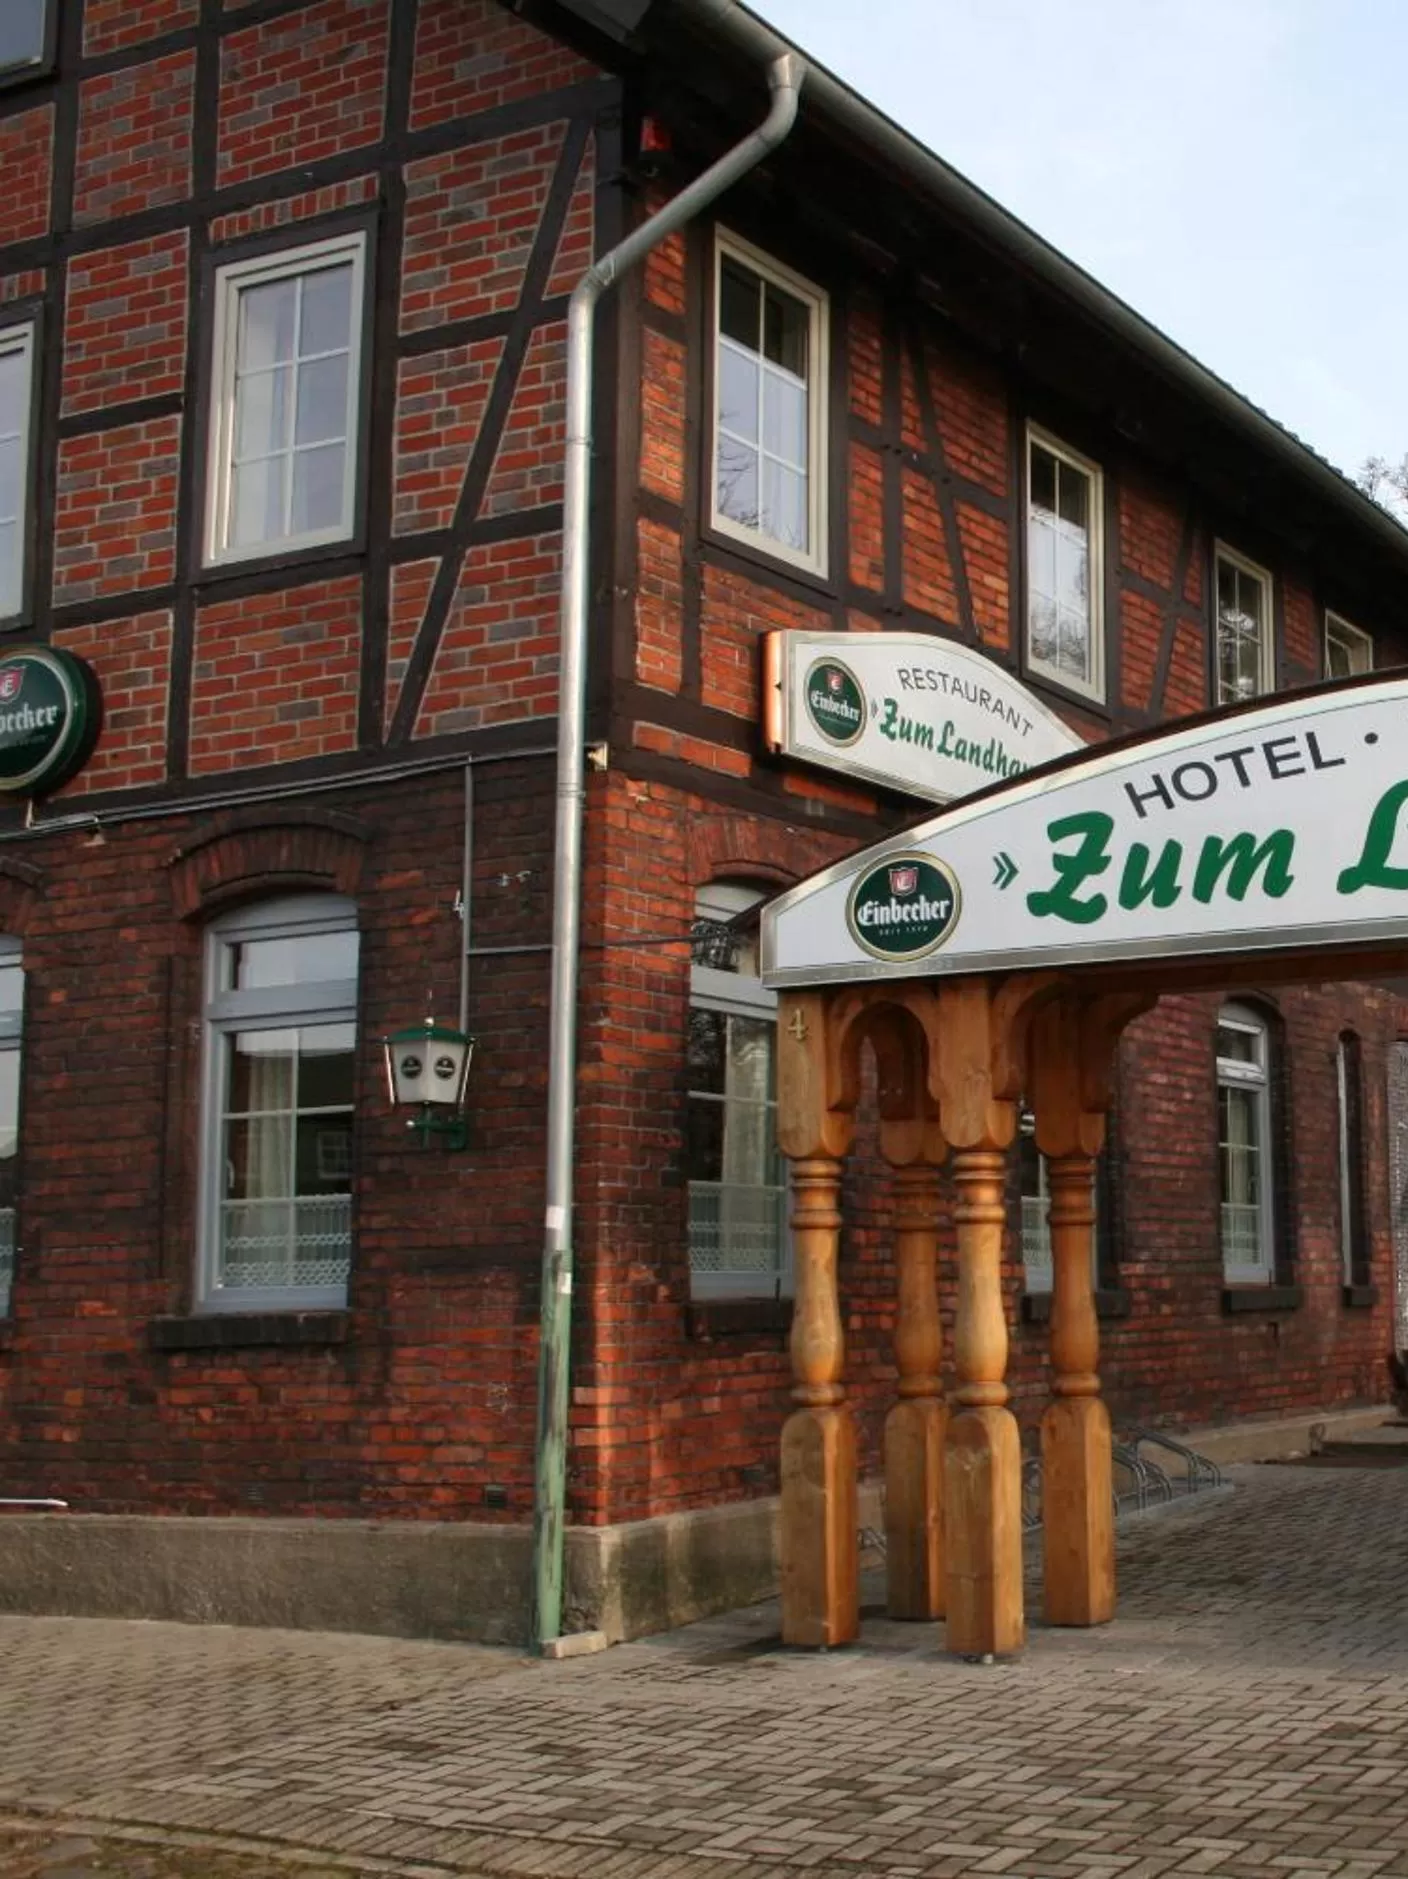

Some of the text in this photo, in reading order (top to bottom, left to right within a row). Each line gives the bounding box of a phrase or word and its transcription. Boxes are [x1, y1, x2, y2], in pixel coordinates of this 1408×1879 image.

[0, 702, 58, 734] ecker
[897, 667, 1034, 737] RESTAURANT
[879, 697, 1032, 778] Zum Landha
[1123, 731, 1346, 819] HOTEL
[1025, 810, 1296, 925] Zum
[857, 894, 951, 927] Einbecker
[787, 1008, 809, 1039] 4
